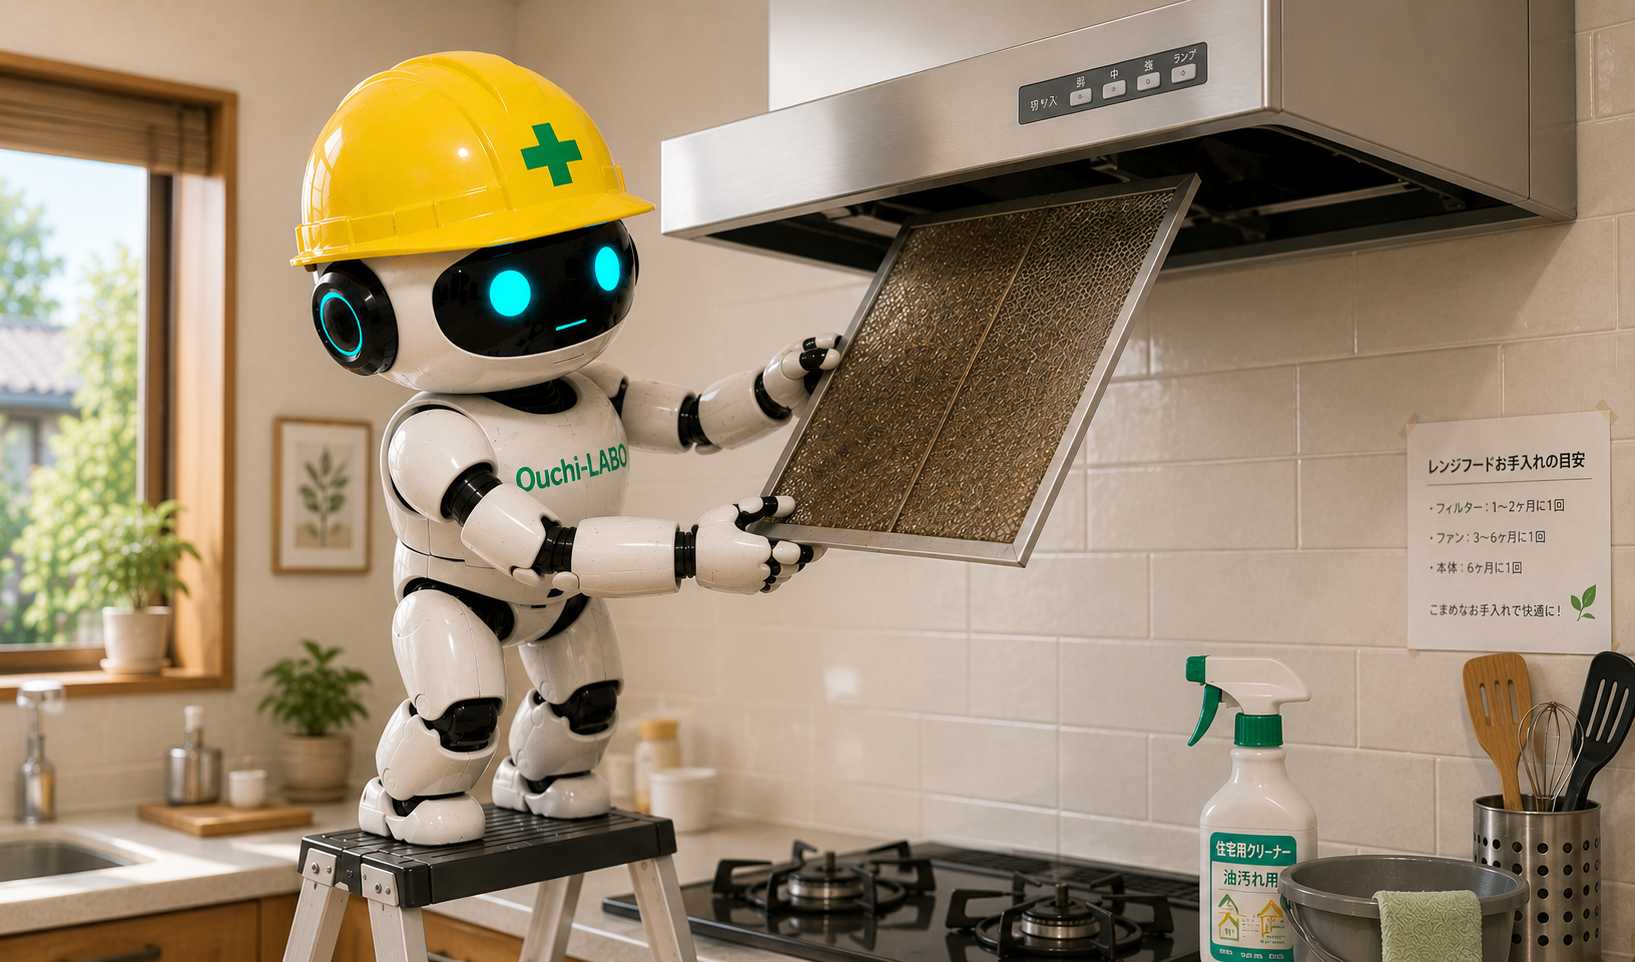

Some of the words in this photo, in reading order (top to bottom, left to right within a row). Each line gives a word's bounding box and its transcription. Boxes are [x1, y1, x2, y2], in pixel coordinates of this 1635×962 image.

[1173, 49, 1197, 64] ランプ
[1110, 68, 1118, 79] 中
[516, 443, 627, 492] Ouchi-LABO
[1428, 451, 1586, 474] レンジフードお手入れの目安
[1216, 840, 1291, 859] 住宅用クリーナー
[1223, 869, 1278, 888] 油汚れ用
